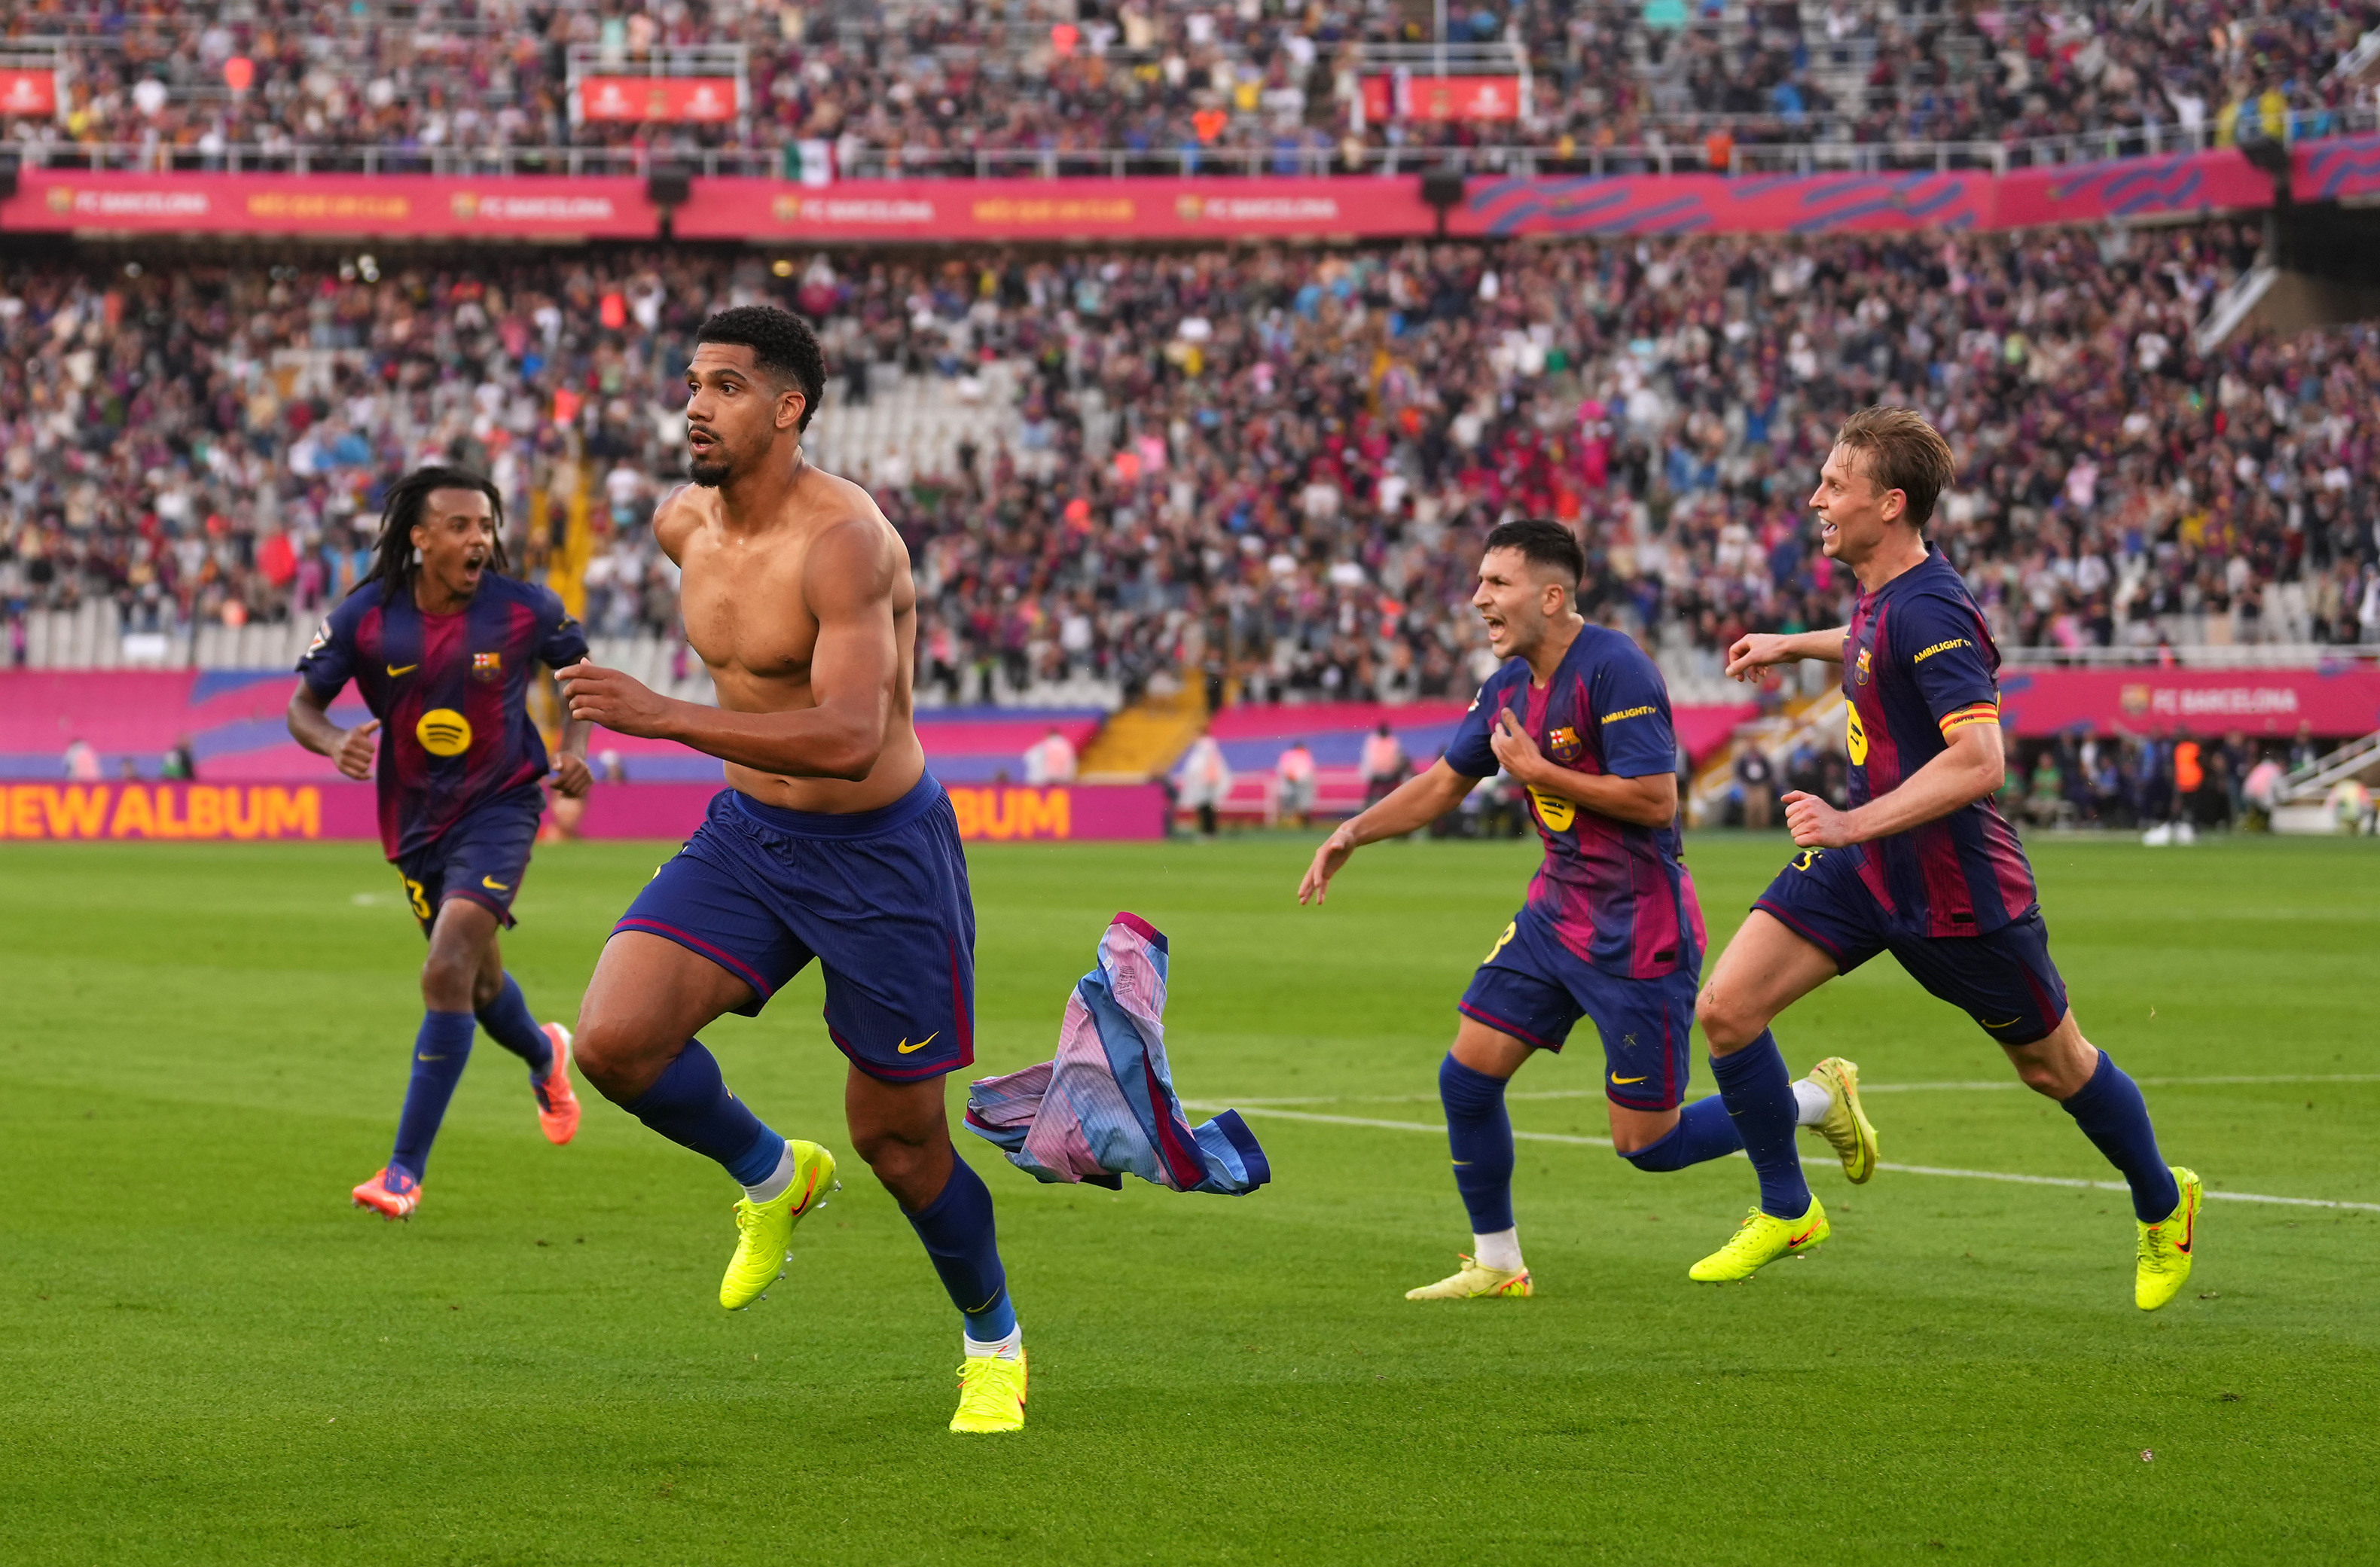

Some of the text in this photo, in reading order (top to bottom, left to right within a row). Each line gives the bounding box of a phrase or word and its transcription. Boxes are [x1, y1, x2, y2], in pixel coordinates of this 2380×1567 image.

[76, 191, 209, 216] FC BARCELONA
[480, 195, 614, 221] FC BARCELONA
[801, 199, 935, 223] FC BARCELONA
[1206, 197, 1338, 221] FC BARCELONA
[1914, 639, 1962, 663] AMBILIGHT
[2153, 687, 2297, 715] FC BARCELONA
[1601, 706, 1648, 724] AMBILIGHT
[0, 785, 320, 840] EW ALBUM
[947, 788, 1070, 840] BUM
[398, 870, 431, 919] 3
